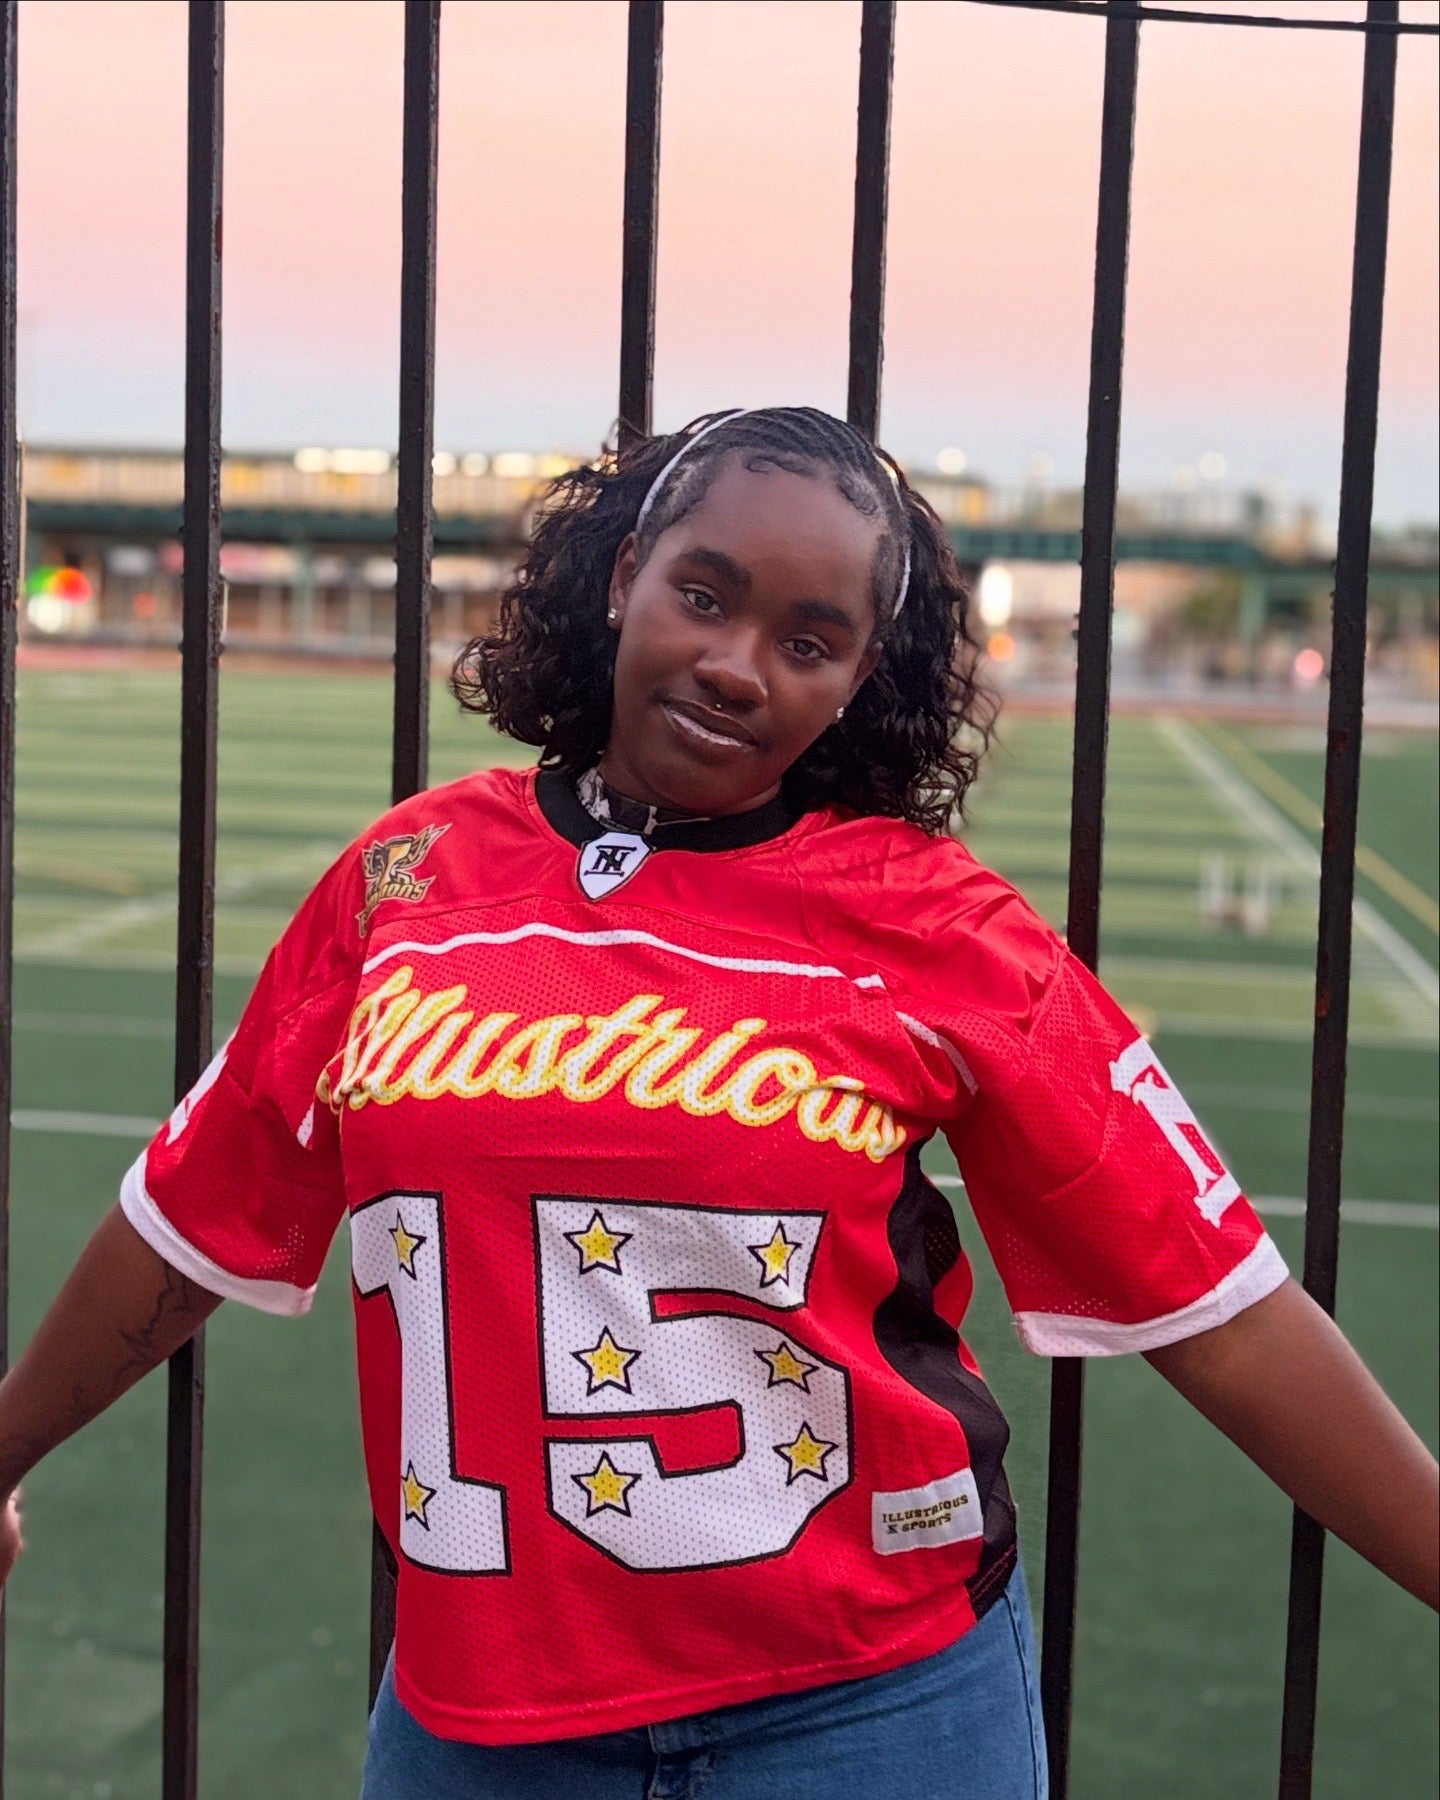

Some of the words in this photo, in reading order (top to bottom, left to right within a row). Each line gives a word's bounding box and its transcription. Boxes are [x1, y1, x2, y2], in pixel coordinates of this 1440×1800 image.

[348, 1189, 855, 1576] 15
[882, 1494, 969, 1523] ILLUSTRIOUS
[901, 1513, 952, 1532] SPORTS
